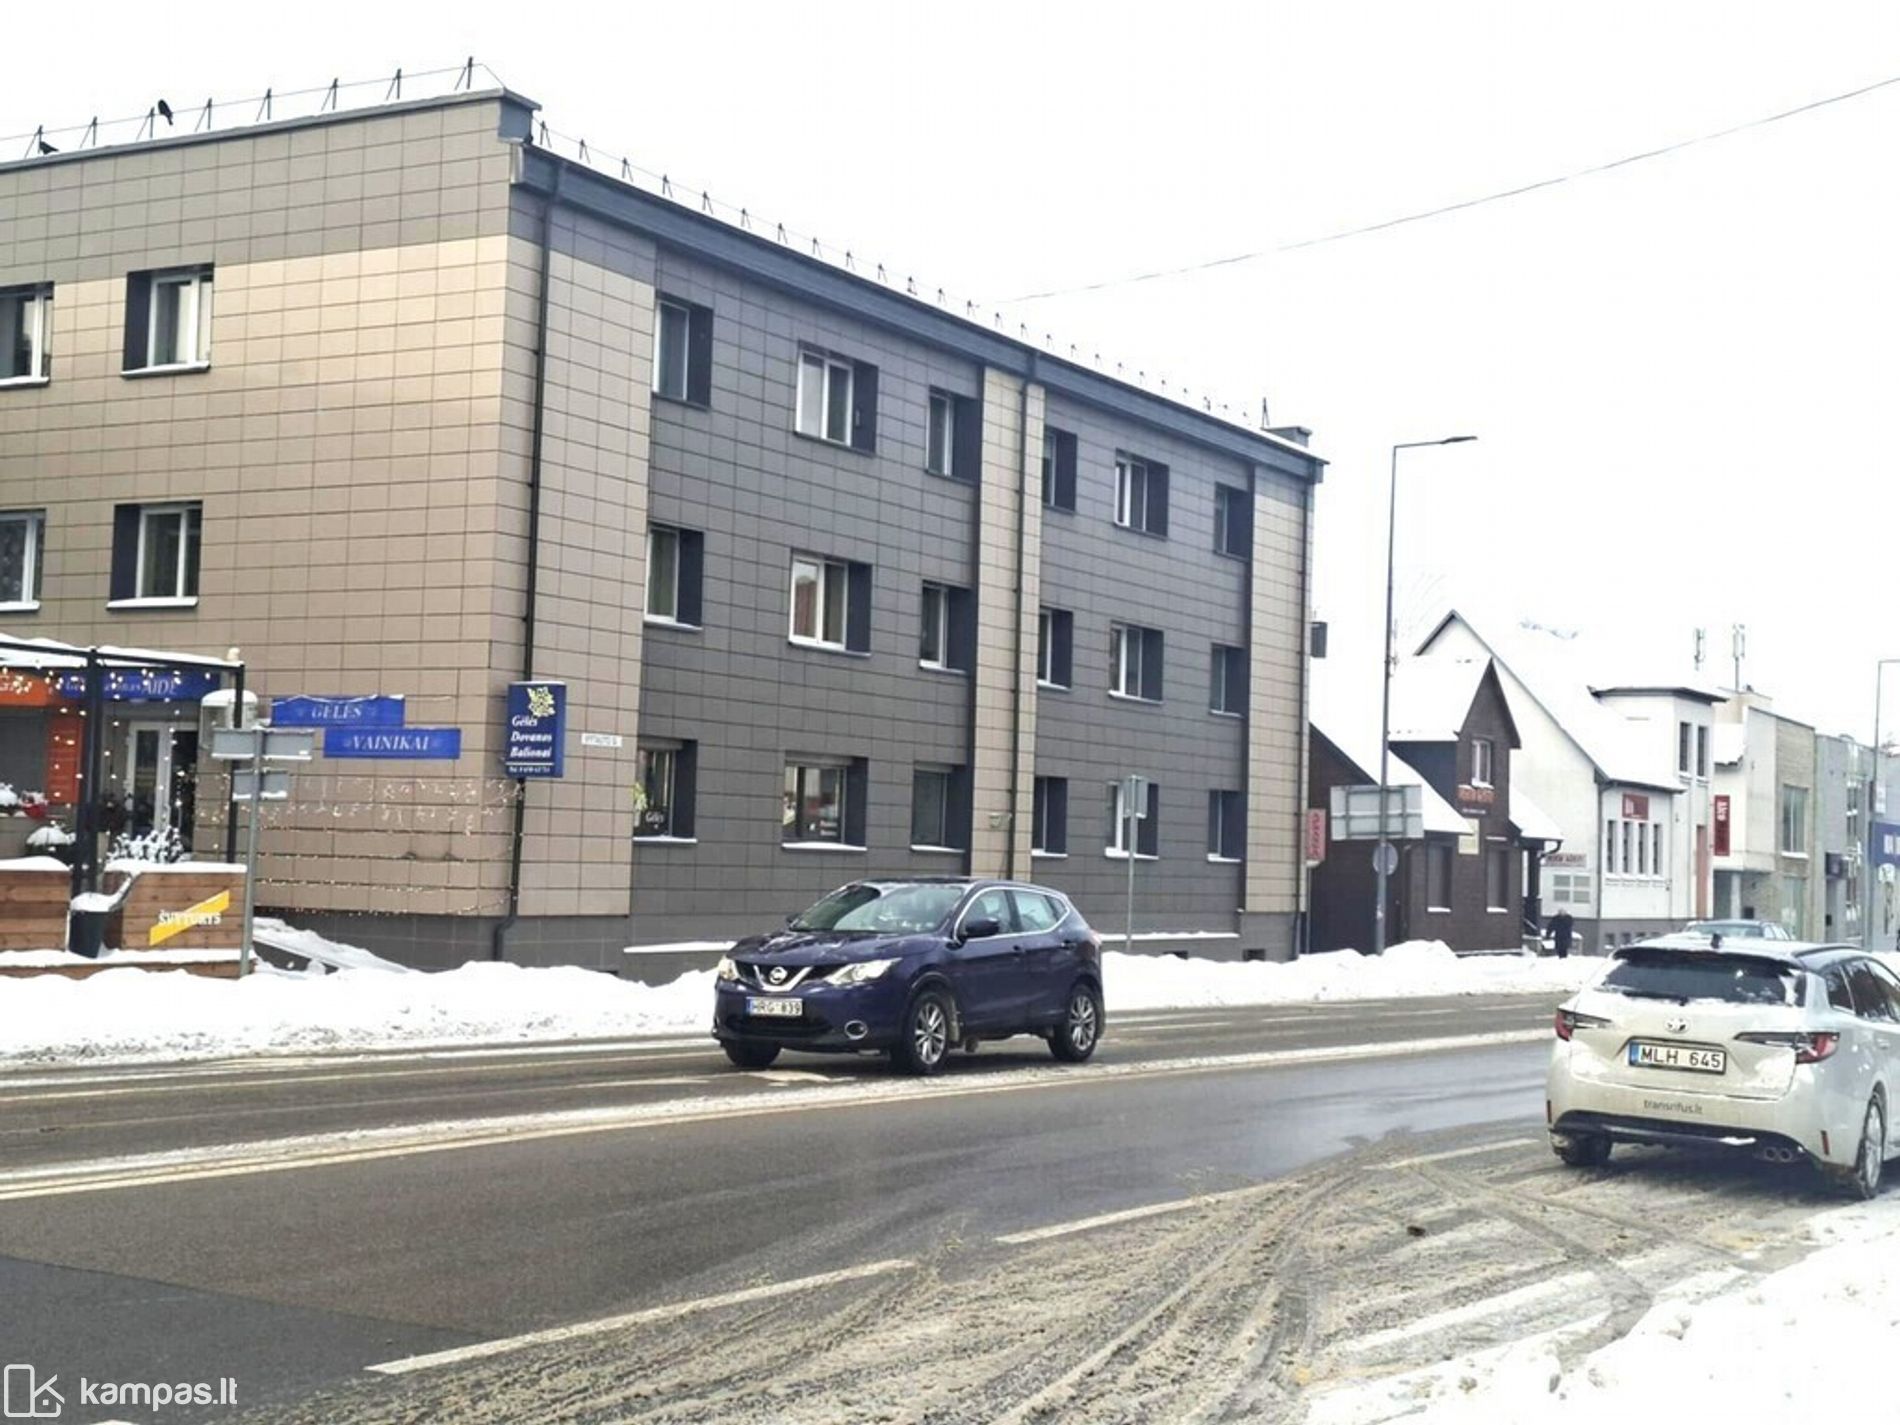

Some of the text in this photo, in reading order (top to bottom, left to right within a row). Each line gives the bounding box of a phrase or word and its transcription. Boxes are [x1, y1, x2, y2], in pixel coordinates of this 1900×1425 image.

[353, 735, 429, 751] VAINIKAI
[1641, 1047, 1721, 1069] MLH 645
